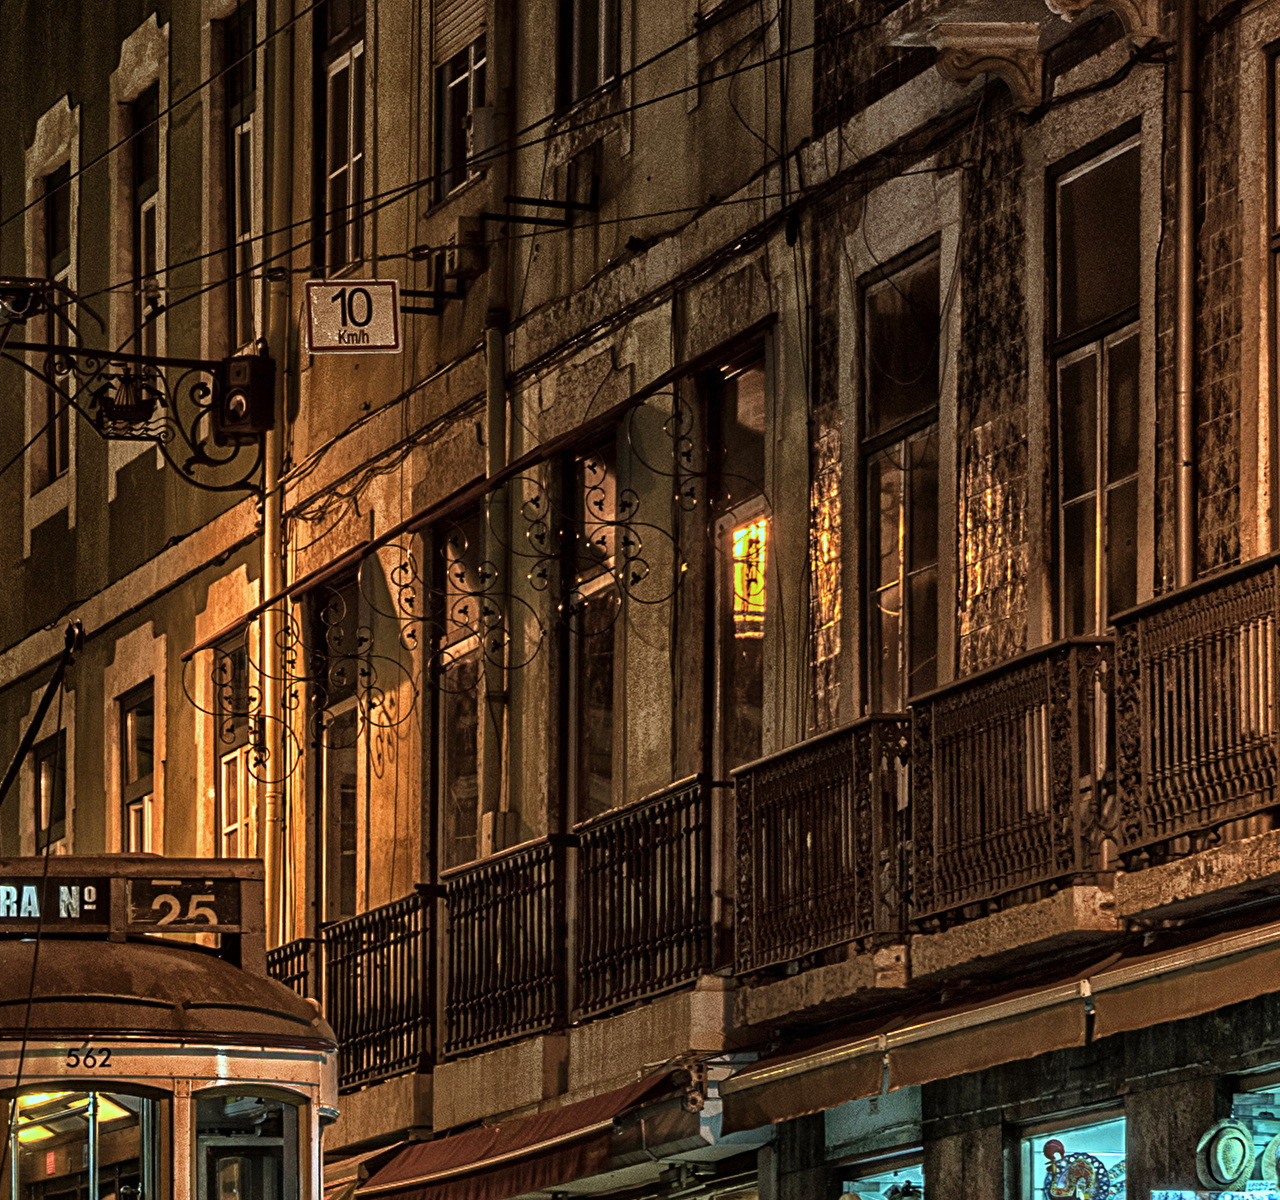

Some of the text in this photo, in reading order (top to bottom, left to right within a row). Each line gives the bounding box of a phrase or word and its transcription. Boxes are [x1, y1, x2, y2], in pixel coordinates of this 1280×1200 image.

[331, 287, 373, 328] 10
[338, 329, 370, 344] Km/h
[151, 894, 218, 926] 25
[66, 1048, 112, 1068] 562
